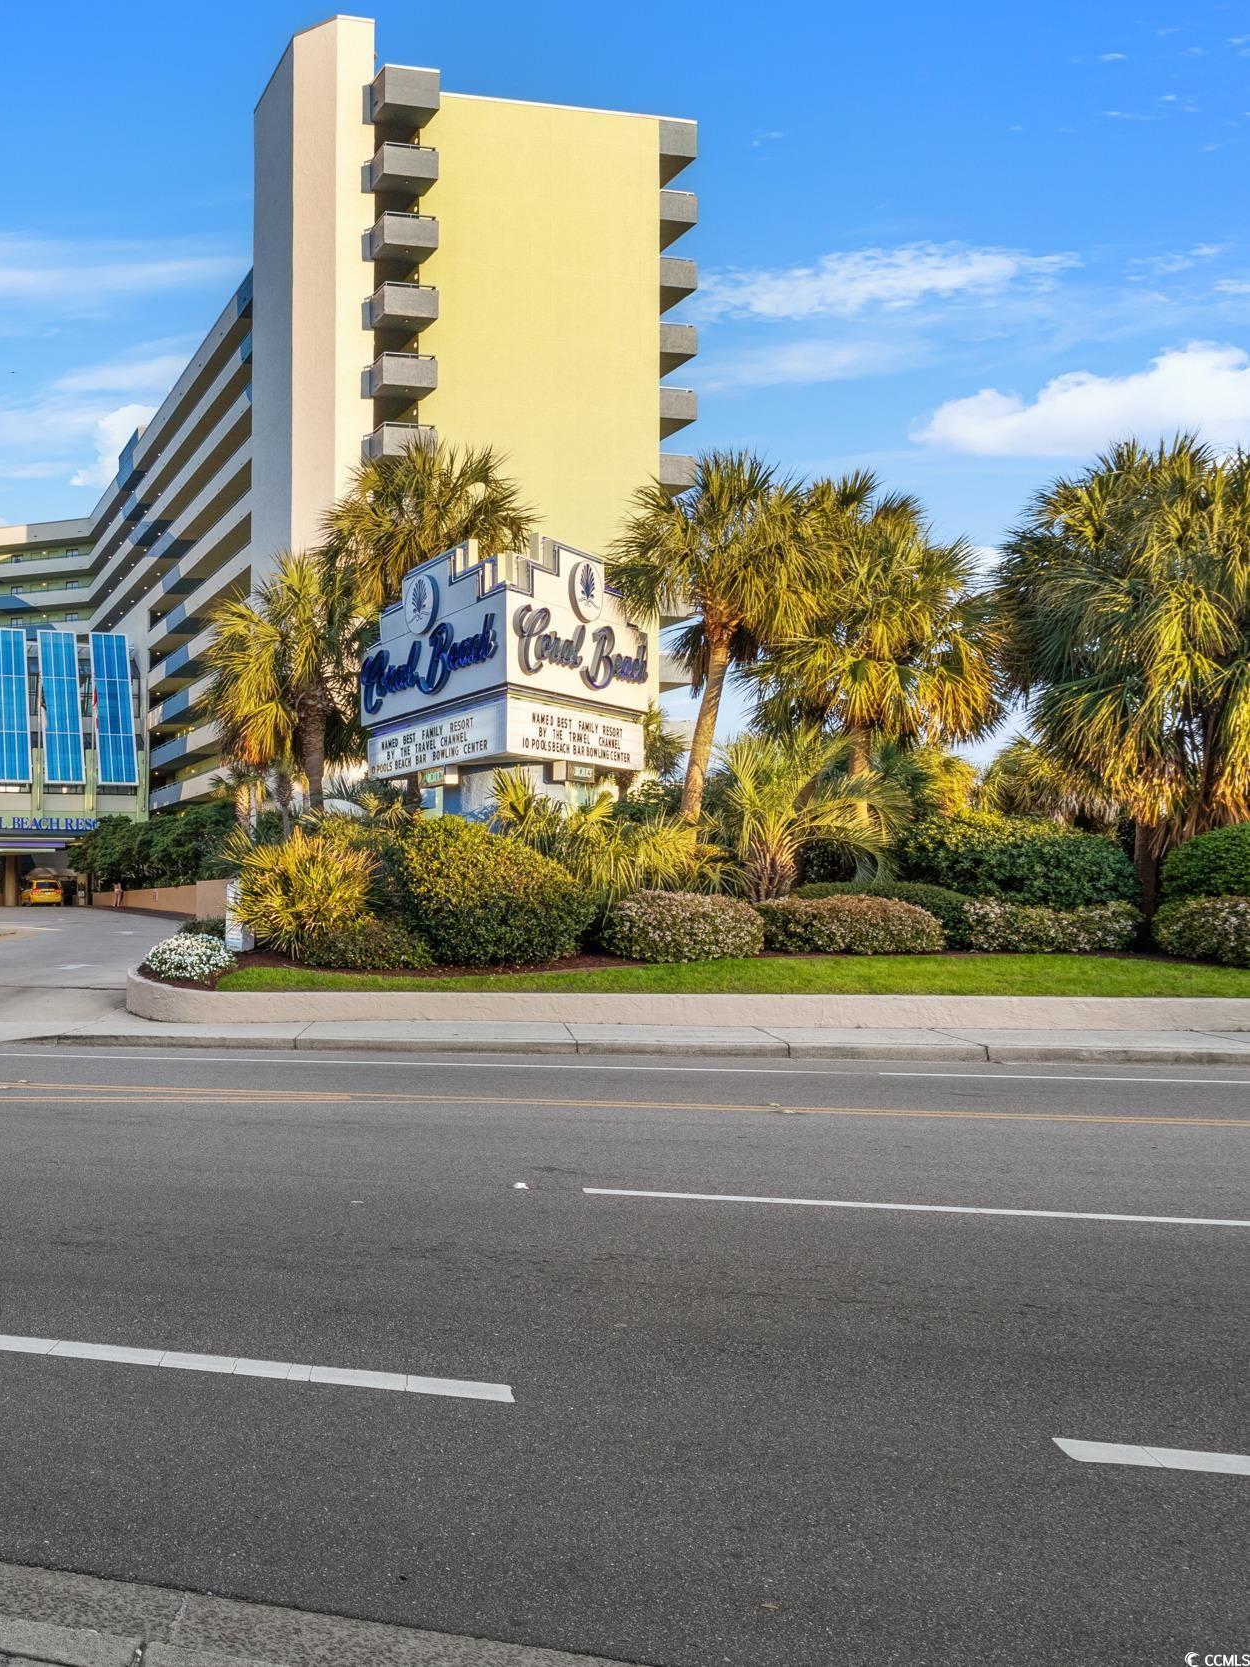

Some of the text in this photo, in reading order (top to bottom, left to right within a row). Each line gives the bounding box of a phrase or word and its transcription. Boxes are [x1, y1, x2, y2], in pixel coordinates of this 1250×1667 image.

[512, 604, 648, 691] Coral Beach
[360, 613, 498, 714] Coral Beach
[382, 718, 474, 751] NAMED BEST FAMILY RESORT
[532, 712, 622, 738] NAMED BEST FAMILY RESORT
[539, 727, 621, 750] BY THE TRAVEL CHANNEL
[377, 762, 392, 775] POOLS
[395, 757, 412, 769] BEACH
[416, 754, 426, 765] BAR
[433, 746, 459, 760] BOWLING
[464, 740, 488, 754] CENTER
[387, 732, 468, 760] BY THE TRAVEL CHANNEL
[532, 739, 551, 751] POOLS
[552, 741, 570, 754] BEACH
[573, 745, 585, 756] BAR
[587, 747, 609, 760] BOWLING
[611, 751, 630, 763] CENTER
[12, 816, 60, 830] BEACH
